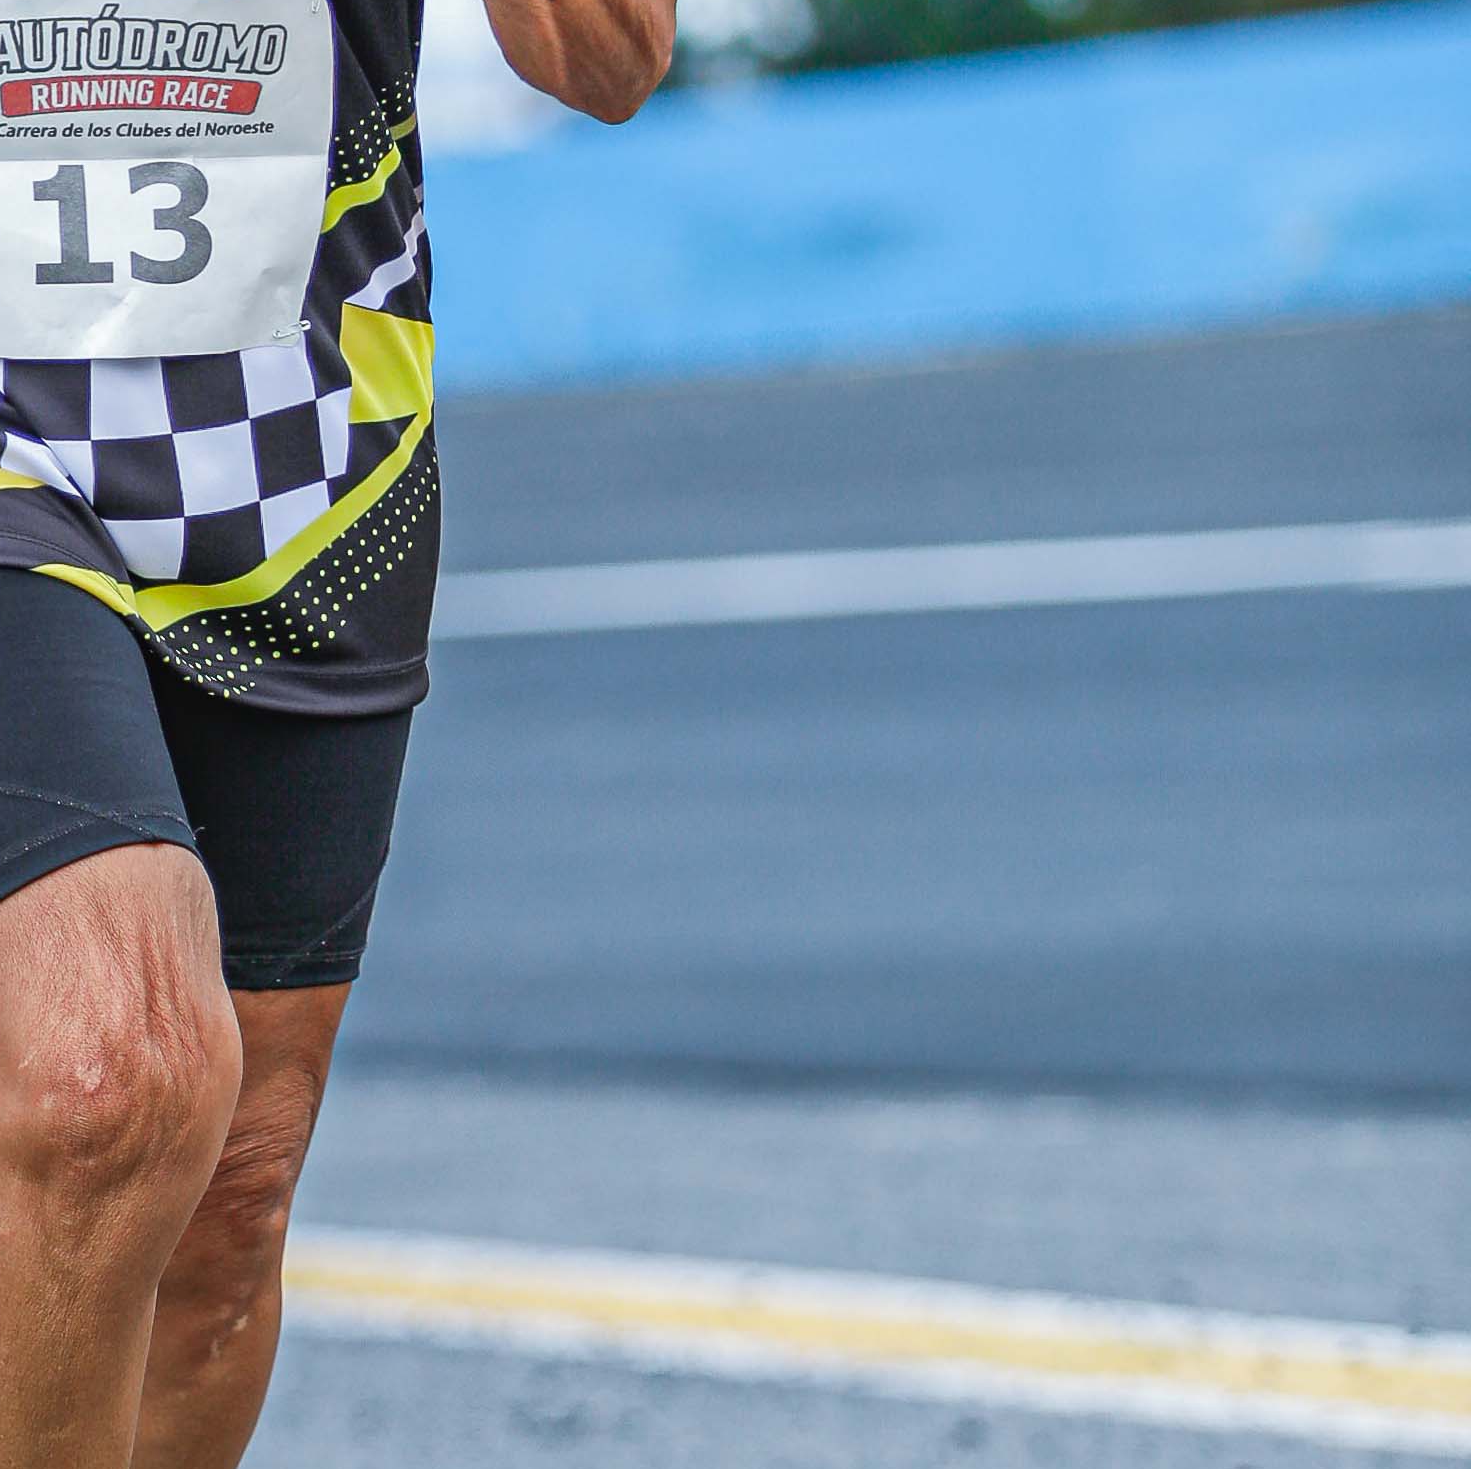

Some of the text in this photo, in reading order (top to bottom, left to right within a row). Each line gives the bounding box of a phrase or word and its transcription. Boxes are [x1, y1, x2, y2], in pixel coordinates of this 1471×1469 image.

[31, 80, 234, 111] RUNNING RACE
[62, 121, 84, 138] de
[88, 121, 111, 138] los
[116, 121, 171, 137] Clubes
[177, 121, 201, 138] del
[205, 121, 274, 137] Noroeste
[32, 162, 213, 285] 13
